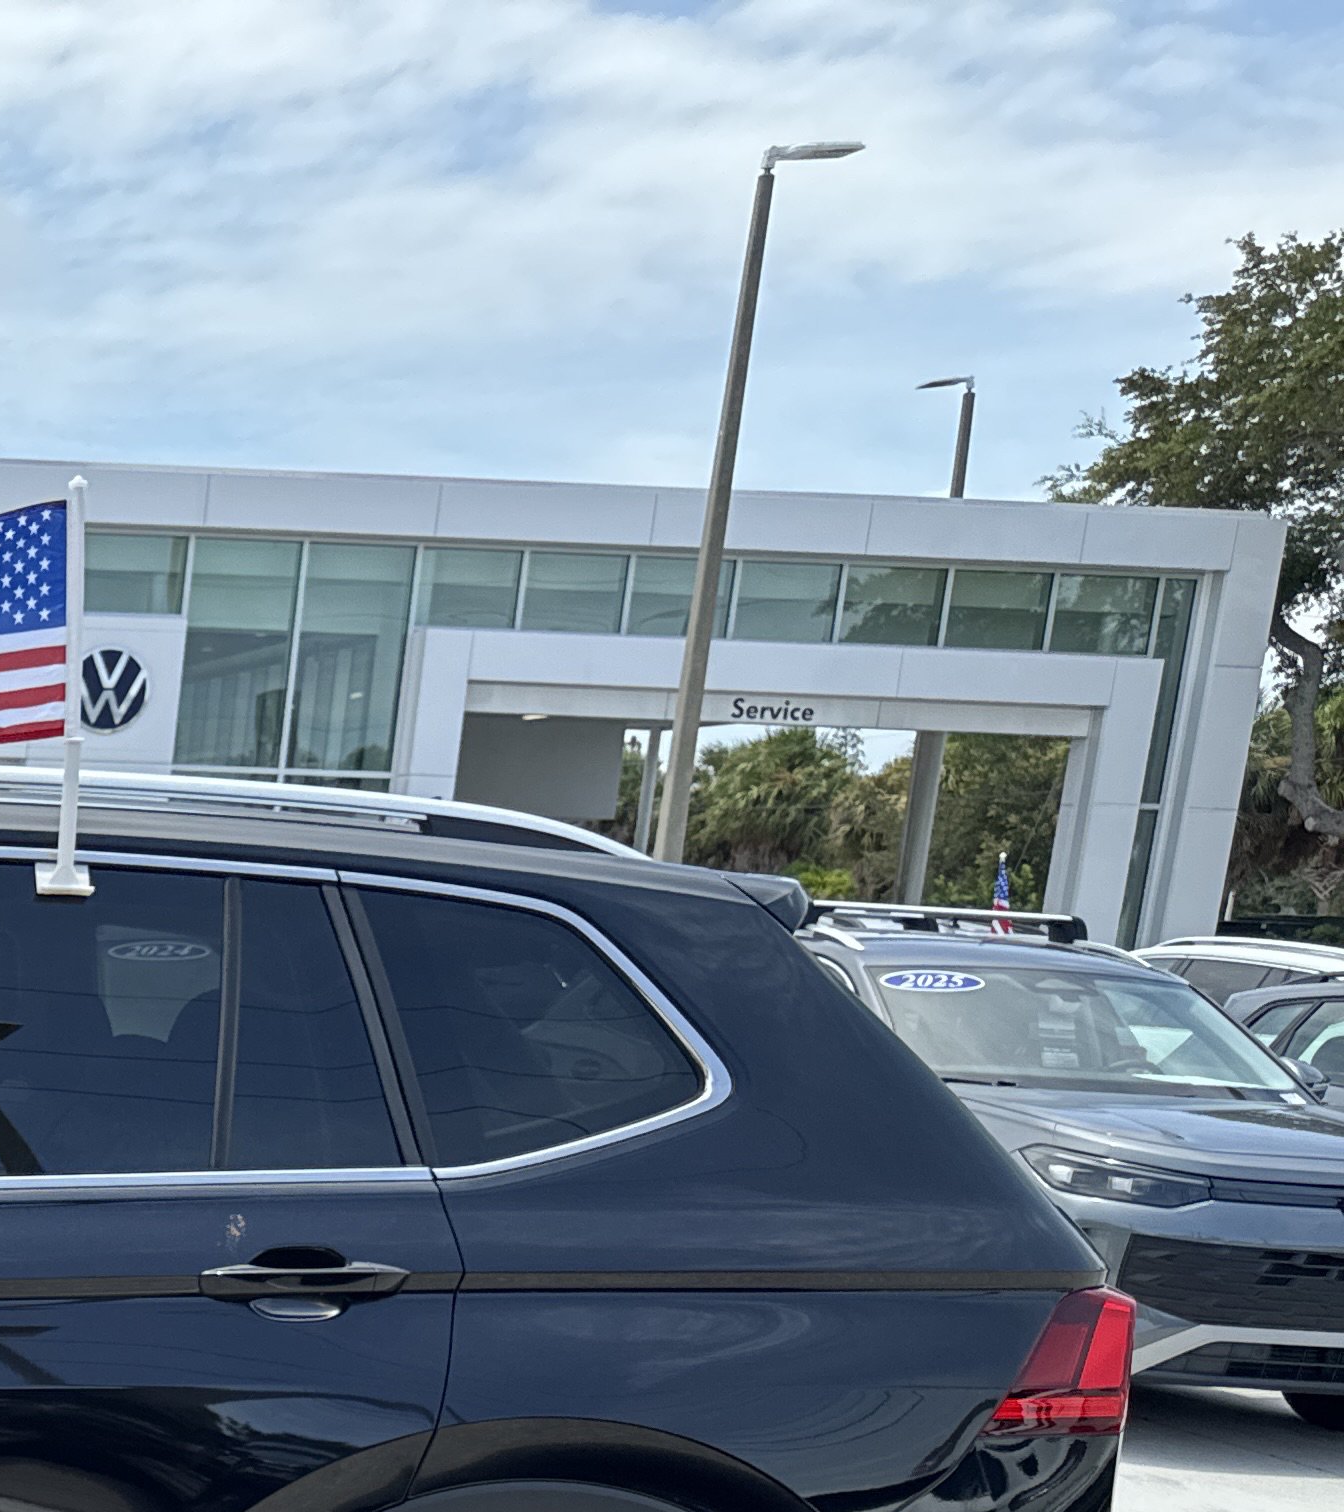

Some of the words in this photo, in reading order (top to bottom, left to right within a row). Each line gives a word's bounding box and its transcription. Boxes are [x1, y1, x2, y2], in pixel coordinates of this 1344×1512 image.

[81, 652, 150, 733] VW
[730, 697, 815, 722] Service
[124, 943, 194, 957] 2024
[901, 973, 965, 988] 2025
